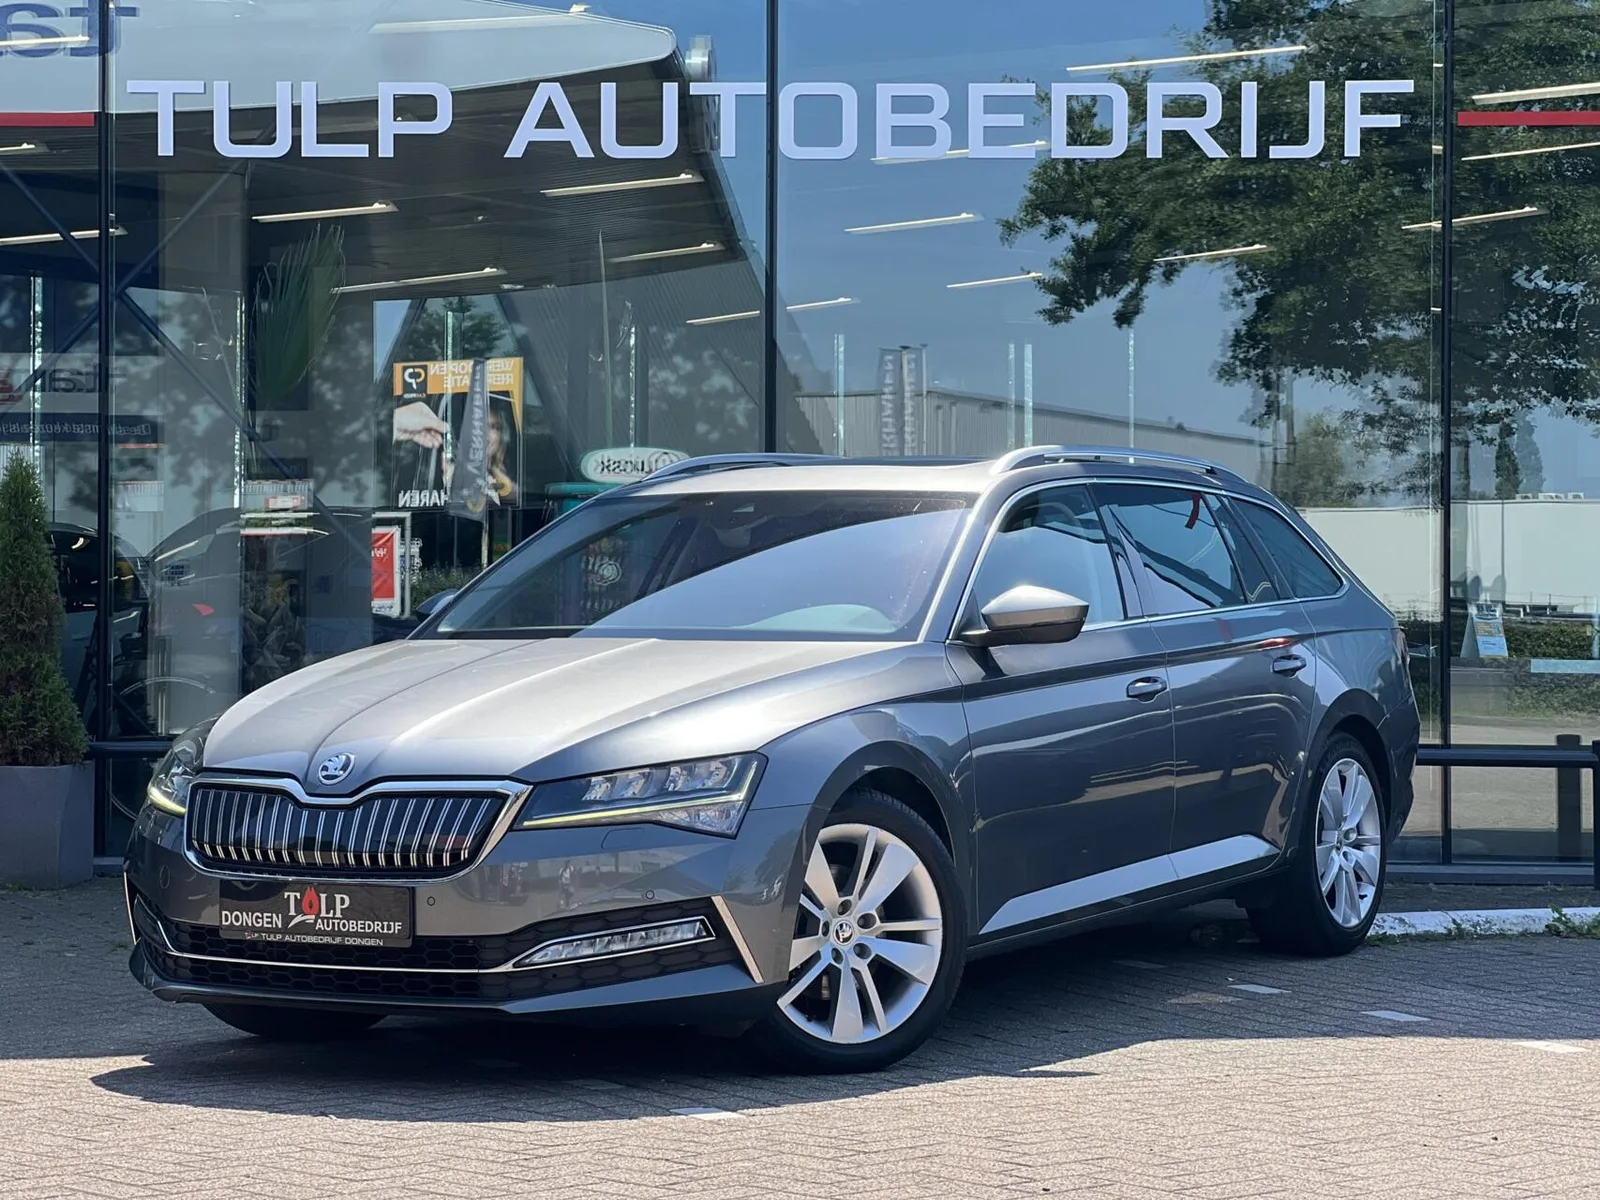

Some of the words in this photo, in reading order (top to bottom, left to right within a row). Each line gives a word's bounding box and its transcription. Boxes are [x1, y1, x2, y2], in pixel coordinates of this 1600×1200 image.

[127, 80, 453, 158] TULP
[503, 80, 1414, 160] AUTOBEDRIJF
[221, 911, 282, 929] DONGEN
[315, 919, 402, 934] AUTOBEDRIJF
[261, 933, 282, 941] TULP
[285, 935, 342, 945] AUTOBEDRIJF
[345, 937, 384, 946] DONGEN
